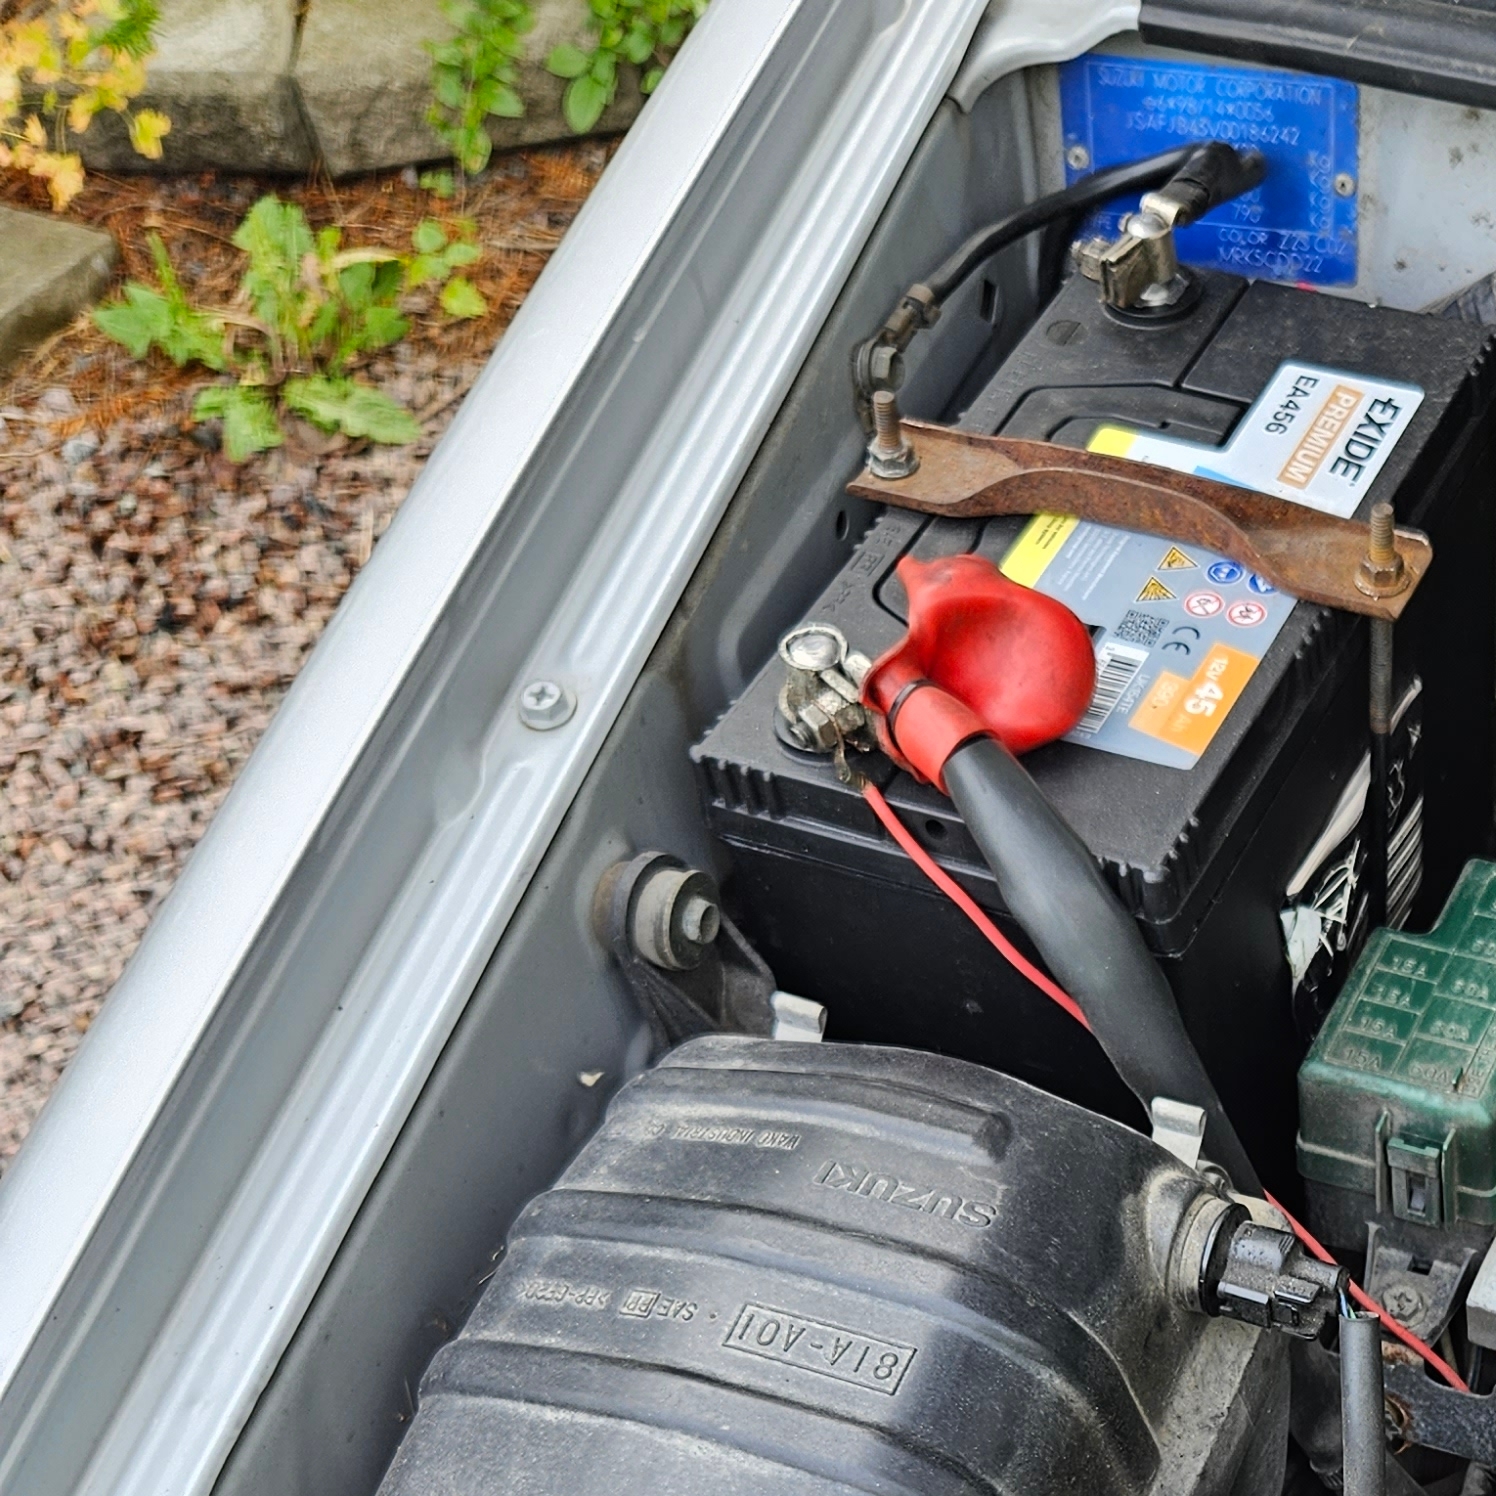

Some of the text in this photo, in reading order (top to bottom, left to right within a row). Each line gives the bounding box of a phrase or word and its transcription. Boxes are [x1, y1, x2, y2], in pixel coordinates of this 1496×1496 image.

[1097, 66, 1322, 105] SUZUKI MOTOR CORPORATION
[1263, 374, 1317, 435] EA456
[1281, 390, 1353, 485] PREMIUM
[1329, 395, 1401, 482] EXIDE
[1205, 657, 1229, 681] 12V
[1181, 680, 1226, 717] 45
[1340, 1045, 1383, 1069] 15A
[809, 1158, 999, 1231] SUZUKI
[655, 1296, 698, 1322] SAE
[736, 1312, 900, 1382] 81A-A01
